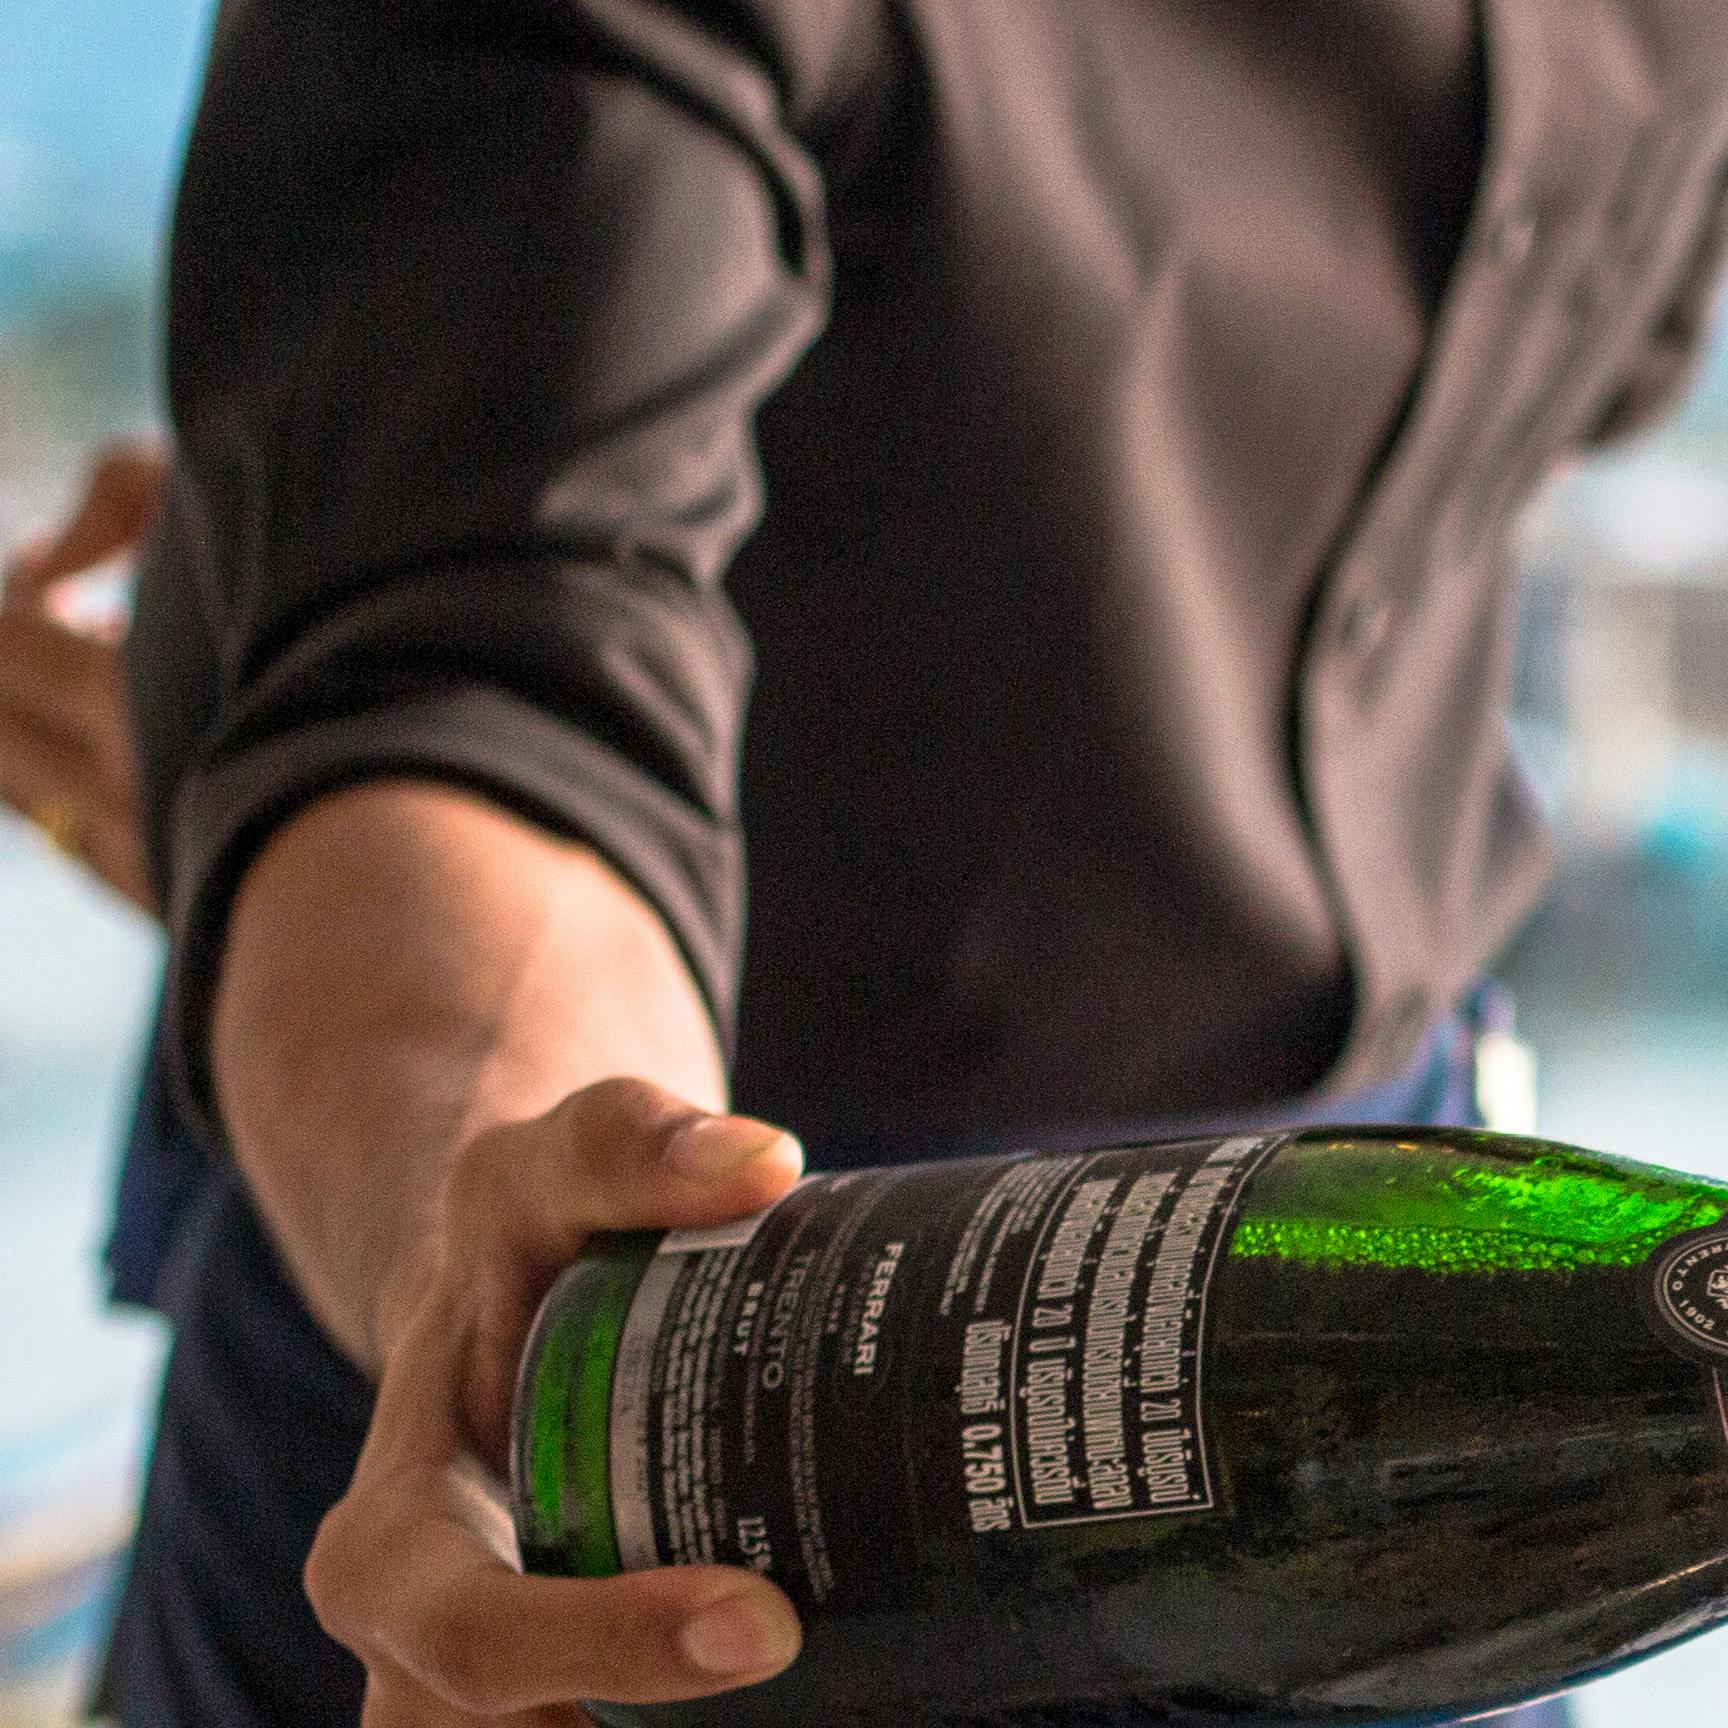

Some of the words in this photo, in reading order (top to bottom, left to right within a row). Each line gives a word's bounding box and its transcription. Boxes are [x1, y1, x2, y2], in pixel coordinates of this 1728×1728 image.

[762, 1250, 816, 1389] TRENTO
[853, 1241, 904, 1375] FERRARI
[1031, 1304, 1074, 1328] 20
[1140, 1399, 1180, 1422] 20
[962, 1422, 1006, 1493] 0.750
[968, 1498, 1014, 1532] ลิตร
